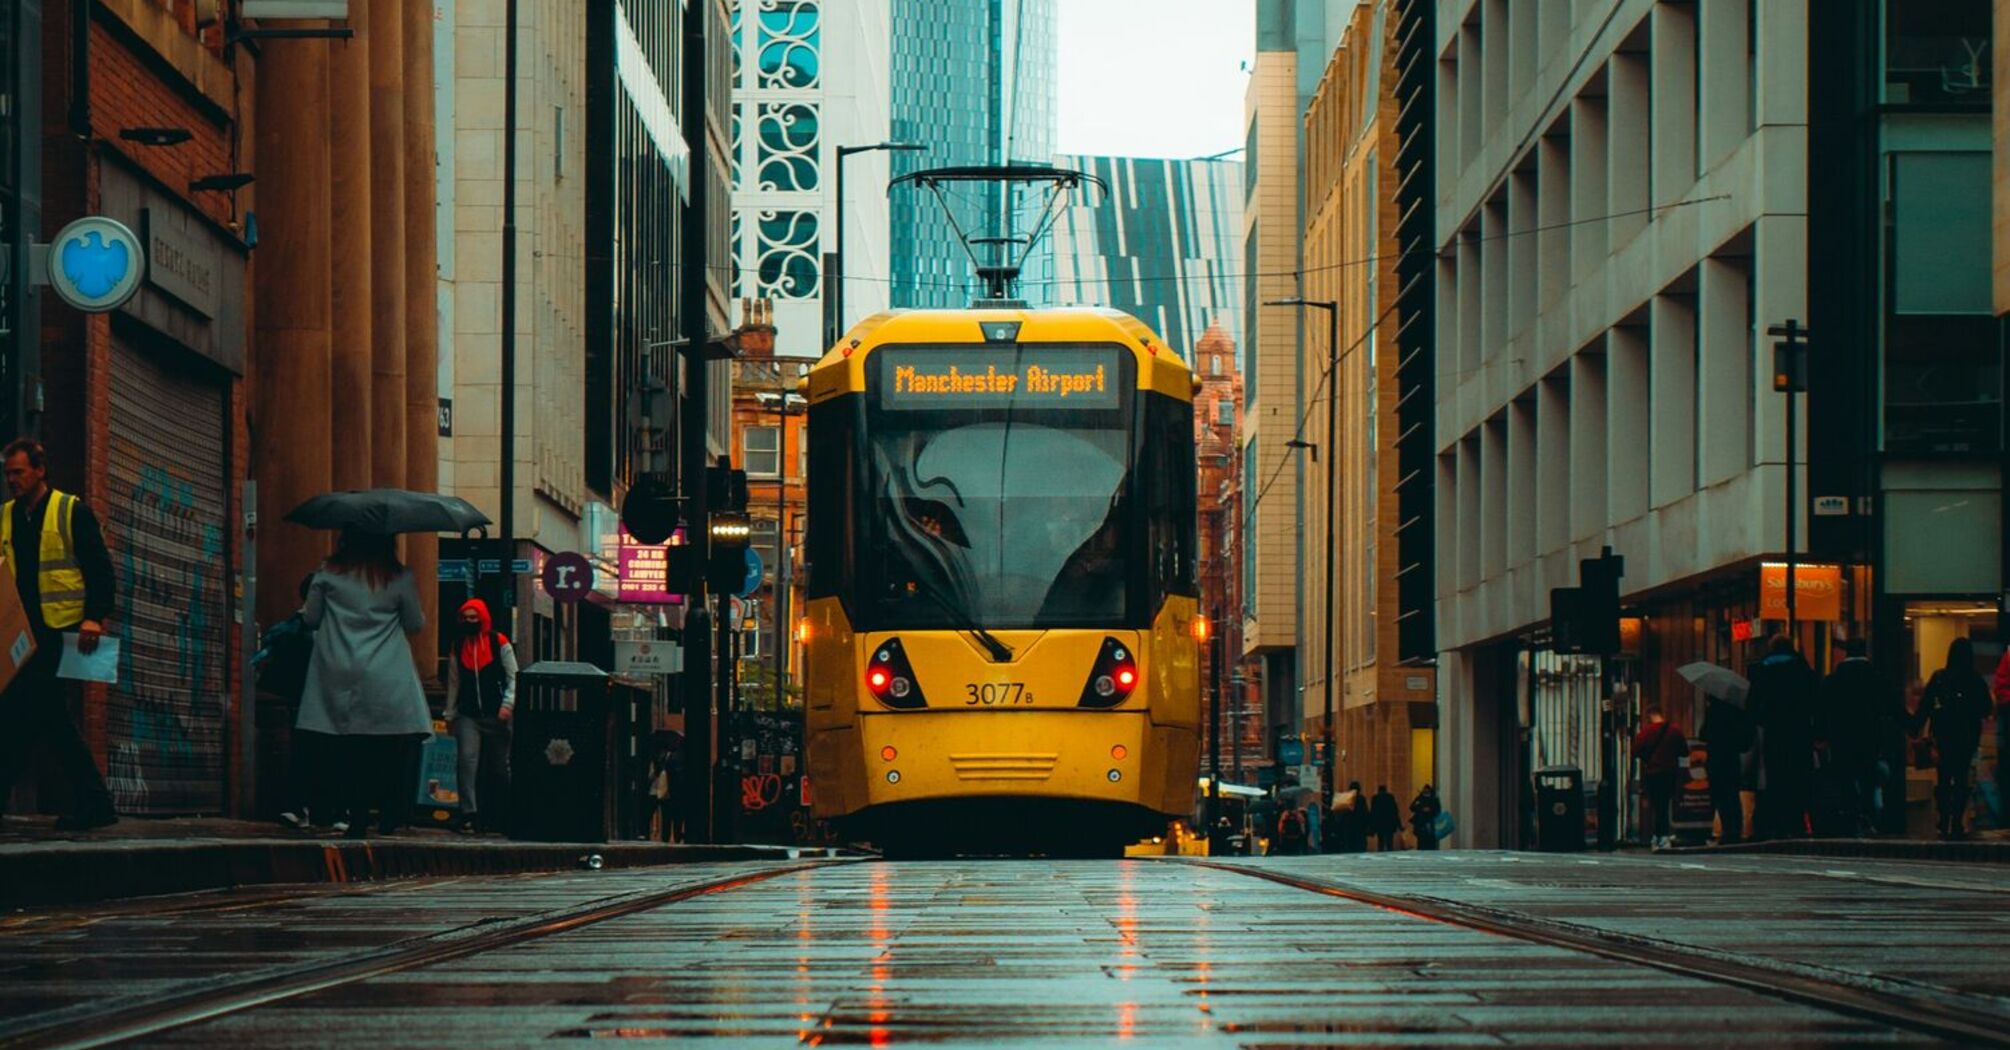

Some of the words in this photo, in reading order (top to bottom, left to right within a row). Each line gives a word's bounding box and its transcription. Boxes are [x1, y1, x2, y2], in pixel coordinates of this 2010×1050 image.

[895, 365, 1018, 393] Manchester
[1027, 364, 1105, 397] Airport
[629, 570, 667, 579] LAWYER
